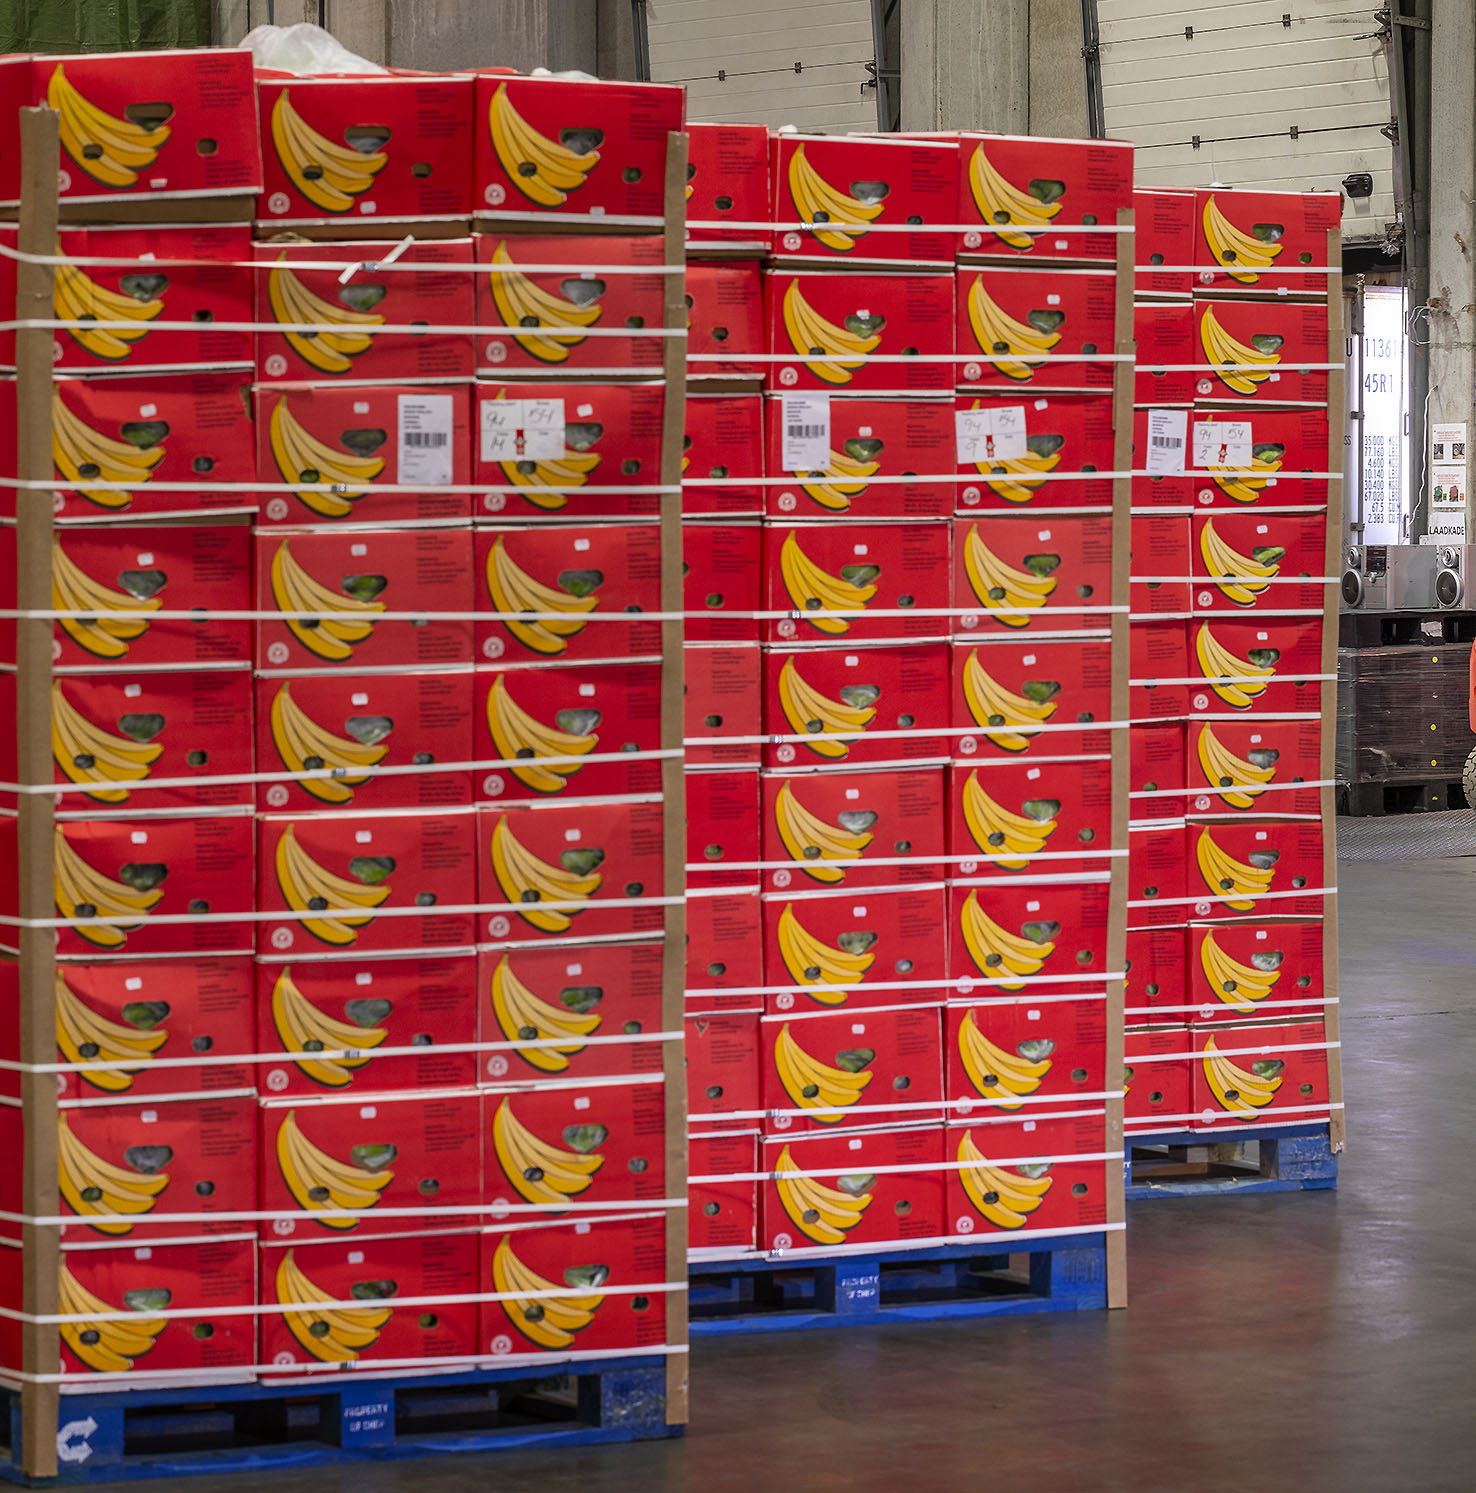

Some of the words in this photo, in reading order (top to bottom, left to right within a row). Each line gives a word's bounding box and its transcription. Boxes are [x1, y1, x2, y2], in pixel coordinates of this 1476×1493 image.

[1364, 373, 1393, 393] 45R1
[1367, 457, 1384, 468] 4.600
[1364, 468, 1384, 479] 10.140
[1371, 502, 1384, 513] 67.5
[1367, 513, 1384, 524] 2.383
[1429, 526, 1465, 536] LAADKADE
